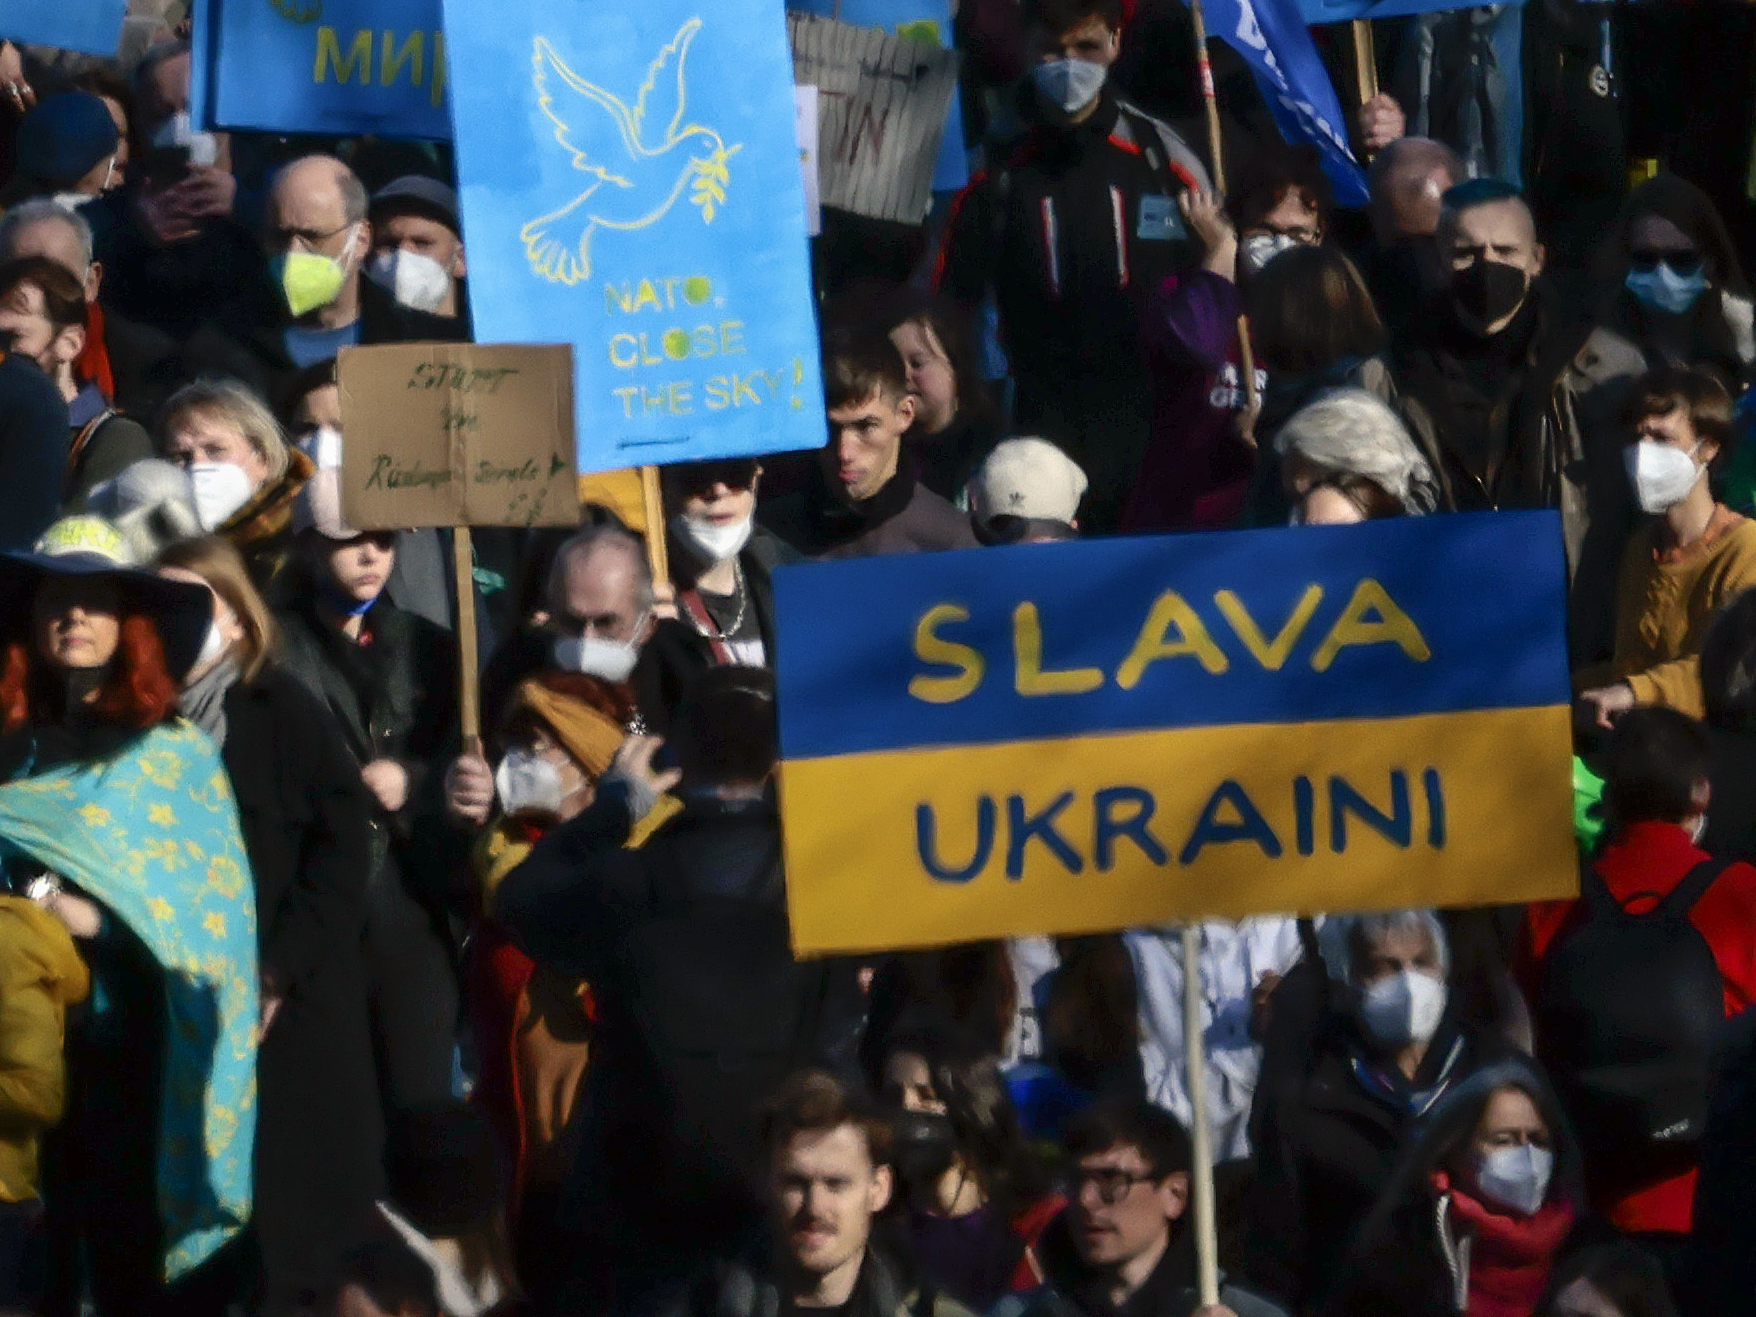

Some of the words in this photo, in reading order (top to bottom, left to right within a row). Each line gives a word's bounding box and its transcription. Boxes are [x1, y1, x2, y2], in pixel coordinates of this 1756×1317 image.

[313, 24, 445, 109] ми
[608, 319, 747, 369] CLOSE
[611, 380, 695, 419] THE
[907, 577, 1432, 705] SLAVA
[914, 766, 1448, 884] UKRAINI
